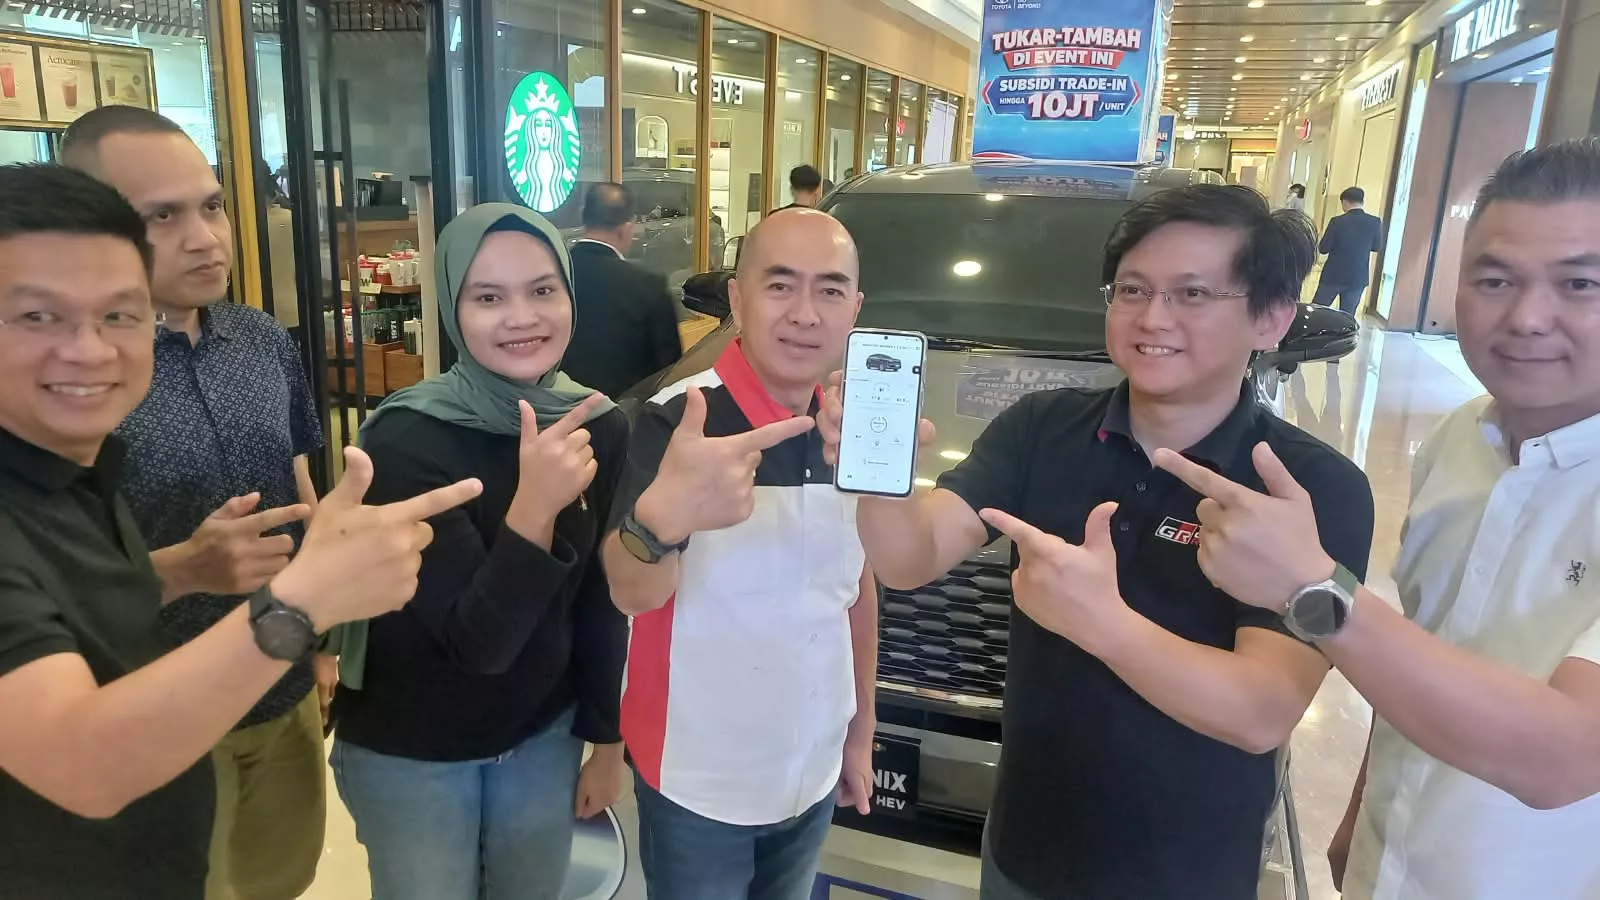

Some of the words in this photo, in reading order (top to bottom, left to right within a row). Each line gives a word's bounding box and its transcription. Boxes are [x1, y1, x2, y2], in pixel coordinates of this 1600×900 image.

[992, 27, 1141, 50] TUKAR-TAMBAH
[1013, 52, 1030, 66] DI
[1034, 51, 1089, 64] EVENT
[1091, 52, 1114, 66] INI
[1000, 78, 1056, 92] SUBSIDI
[1058, 78, 1127, 91] TRADE-IN
[999, 97, 1025, 105] HINGGA
[1027, 92, 1099, 118] 10JT
[1158, 525, 1192, 543] GR
[876, 794, 906, 810] HEV
